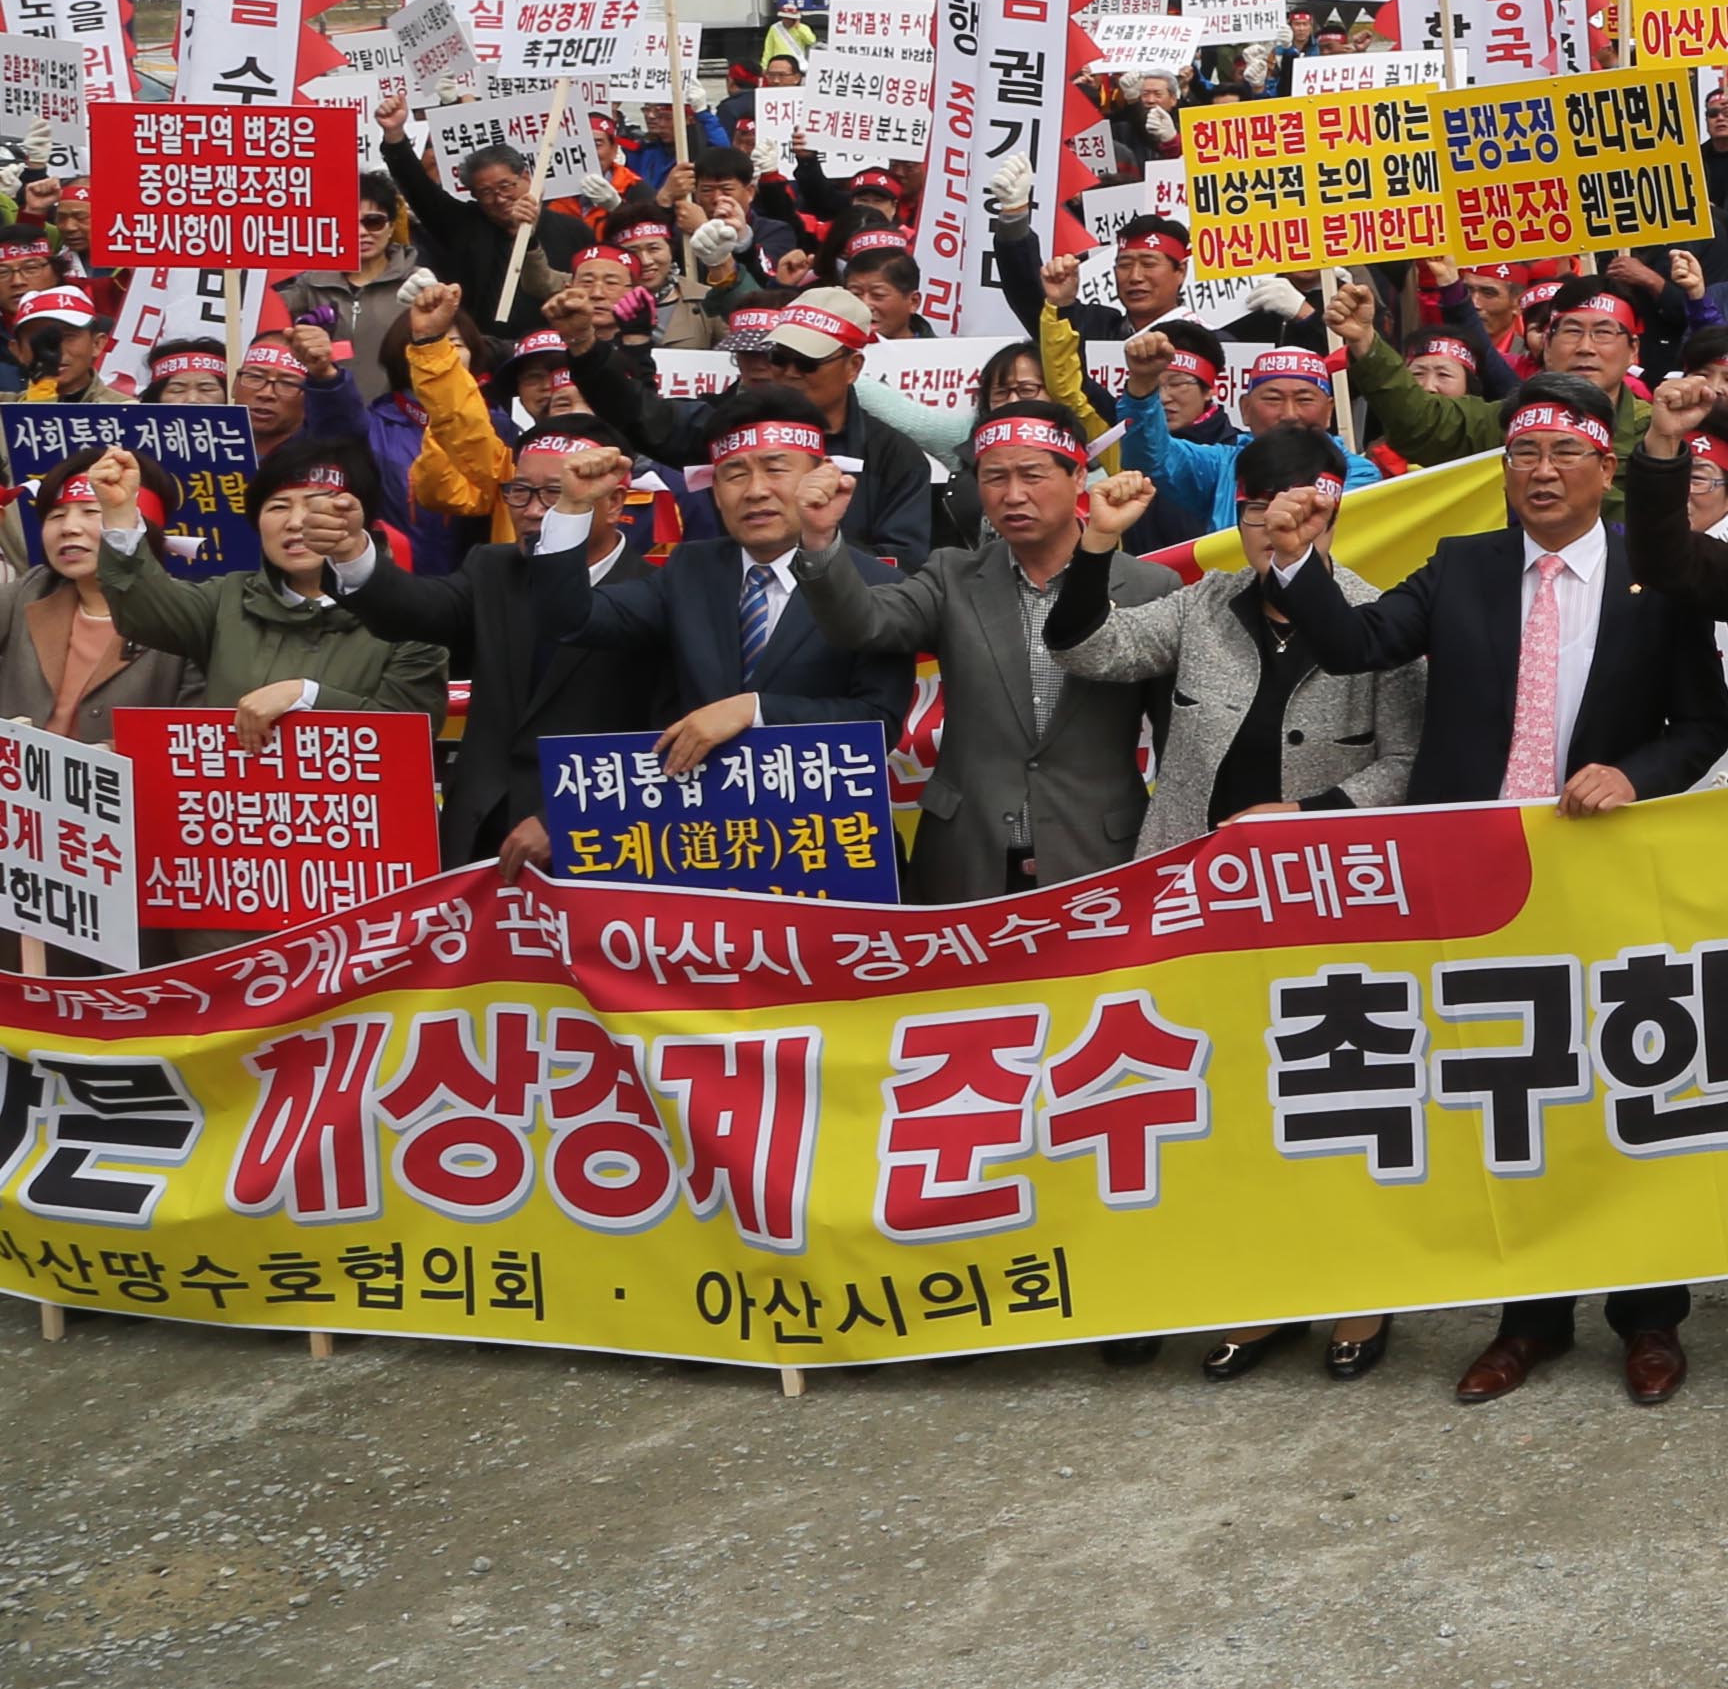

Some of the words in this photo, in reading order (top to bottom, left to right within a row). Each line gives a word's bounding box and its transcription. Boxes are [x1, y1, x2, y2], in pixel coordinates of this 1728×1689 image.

[517, 3, 596, 33] 해상경계
[599, 0, 639, 28] 준수
[1147, 23, 1191, 43] 무시하는
[522, 37, 616, 68] 촉구한다!!
[1136, 49, 1186, 63] 중단하라!
[133, 113, 233, 156] 관할구역
[244, 115, 315, 157] 변경은
[1192, 110, 1306, 163] 헌재판결
[1318, 99, 1430, 147] 무시하는
[1444, 97, 1560, 172] 분쟁조정
[1565, 81, 1684, 157] 한다면서
[139, 164, 312, 207] 중앙분쟁조정위
[920, 80, 976, 337] 중단하라
[1193, 163, 1306, 215] 비상식적
[1318, 157, 1371, 204] 논의
[1383, 151, 1441, 196] 앞에
[1456, 177, 1572, 251] 분쟁조장
[1578, 162, 1696, 238] 웬말이냐
[107, 214, 232, 256] 소관사항이
[242, 215, 344, 257] 아닙니다.
[1199, 217, 1310, 271] 아산시민
[1322, 202, 1446, 257] 분개한다!
[136, 421, 246, 463] 저해하는
[295, 724, 381, 783] 변경은
[720, 745, 877, 807] 저해하는
[64, 759, 121, 824] 따른
[178, 790, 380, 850] 중앙분쟁조정위
[57, 819, 122, 884] 준수
[566, 812, 881, 881] 도계(道界)침탈
[144, 857, 290, 914] 소관사항이
[233, 898, 475, 1010] 경계분쟁
[599, 916, 814, 987] 아산시
[834, 884, 1133, 982] 경계수호
[1150, 839, 1411, 937] 결의대회
[227, 1003, 822, 1252] 해상경계
[875, 987, 1212, 1243] 준수
[694, 1245, 1073, 1345] 아산시의회
